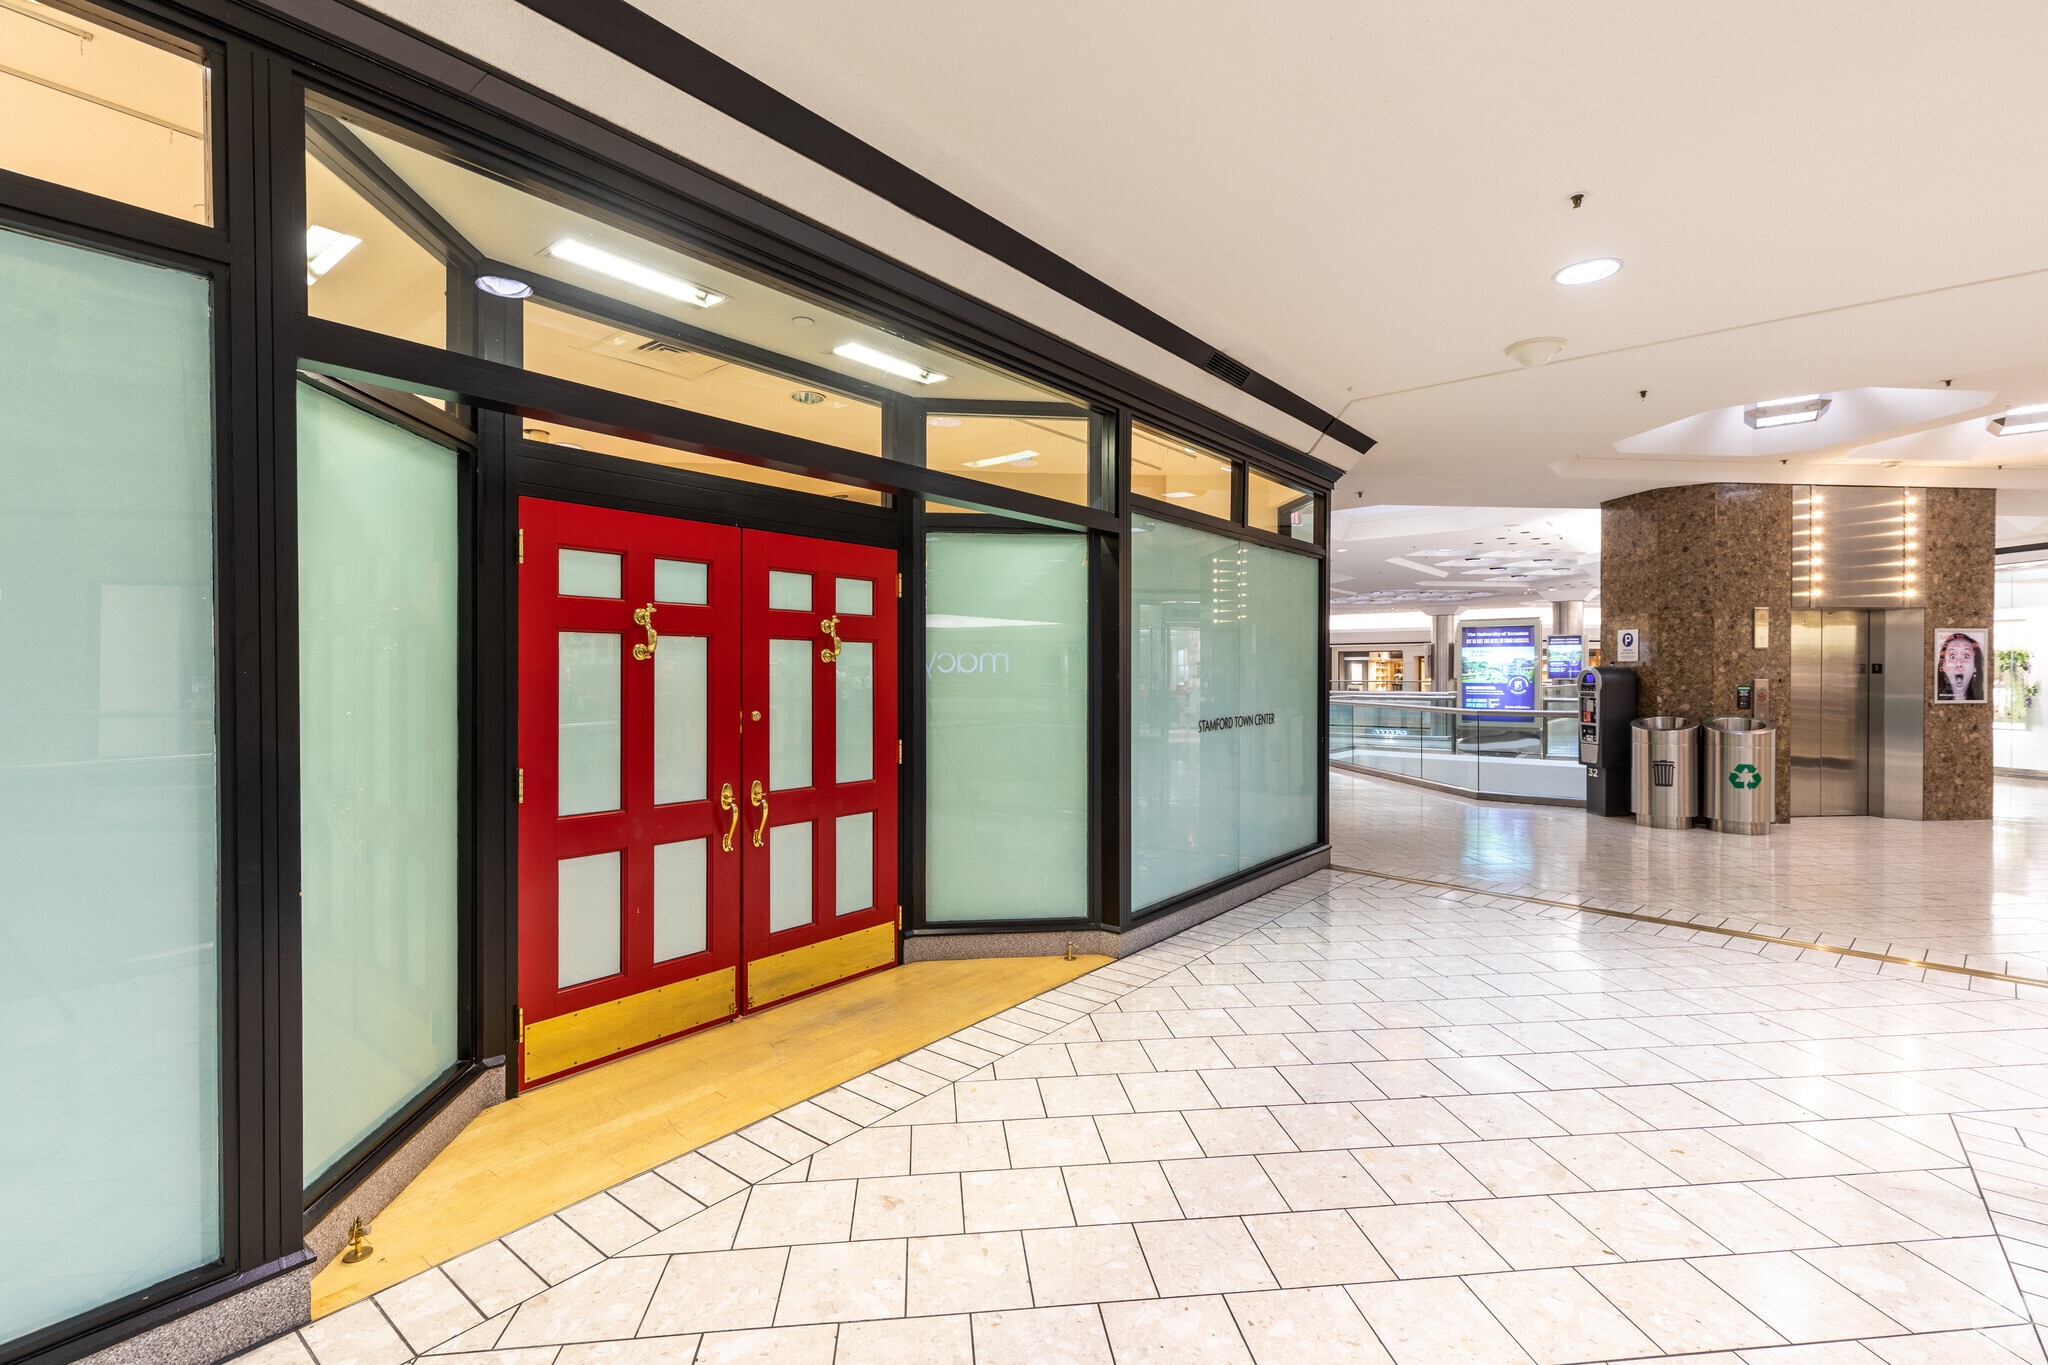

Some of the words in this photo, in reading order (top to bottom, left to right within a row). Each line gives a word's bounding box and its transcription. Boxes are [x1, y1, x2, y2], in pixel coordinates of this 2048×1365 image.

[1198, 716, 1233, 733] STAMFORD
[1234, 714, 1254, 728] TOWN
[1254, 713, 1275, 726] CENTER
[1587, 767, 1599, 777] 32
